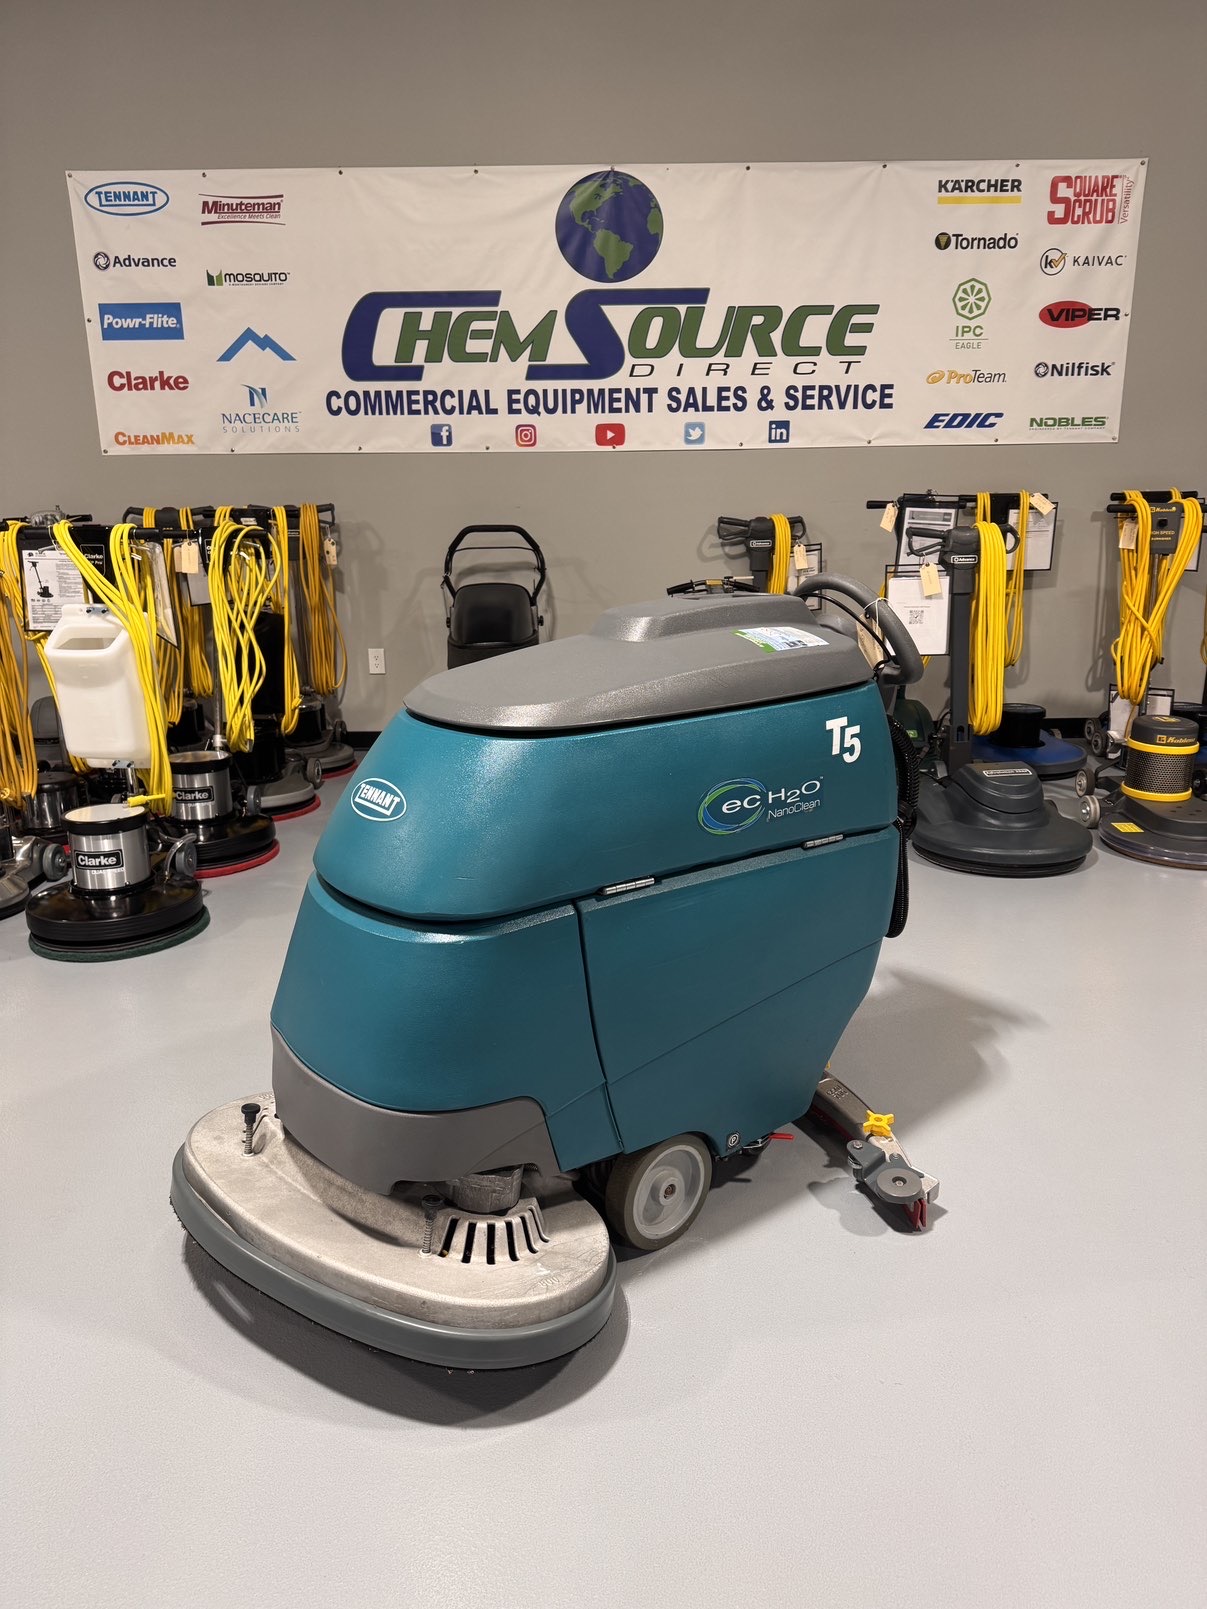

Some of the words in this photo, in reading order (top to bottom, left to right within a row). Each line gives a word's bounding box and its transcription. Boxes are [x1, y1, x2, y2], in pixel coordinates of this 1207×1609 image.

[938, 178, 1022, 193] KÄRCHER
[1050, 174, 1119, 199] SQUARE
[95, 190, 158, 207] TENNANT
[201, 200, 281, 214] Minuteman
[952, 233, 1018, 250] Tornado
[113, 254, 177, 268] Advance
[1072, 255, 1124, 267] KAIVAC
[103, 314, 177, 329] Powr-Flite
[1046, 307, 1120, 322] VIPER
[955, 325, 984, 337] IPC
[955, 342, 982, 350] EAGLE
[629, 361, 861, 378] DIRECT
[946, 369, 1006, 384] ProTeam
[1051, 362, 1112, 377] Nilfisk
[107, 370, 189, 392] Clarke
[326, 389, 499, 416] COMMERCIAL
[507, 387, 658, 416] EQUIPMENT
[667, 385, 748, 413] SALES
[757, 385, 775, 412] &
[784, 383, 895, 411] SERVICE
[221, 412, 299, 425] NACECARE
[923, 412, 1004, 430] EDIC
[1029, 416, 1106, 427] NOBLES
[826, 717, 861, 763] T5
[176, 791, 209, 800] Clarke
[354, 783, 401, 816] TENNANT
[767, 799, 821, 821] NanoClean
[78, 855, 117, 866] Clarke
